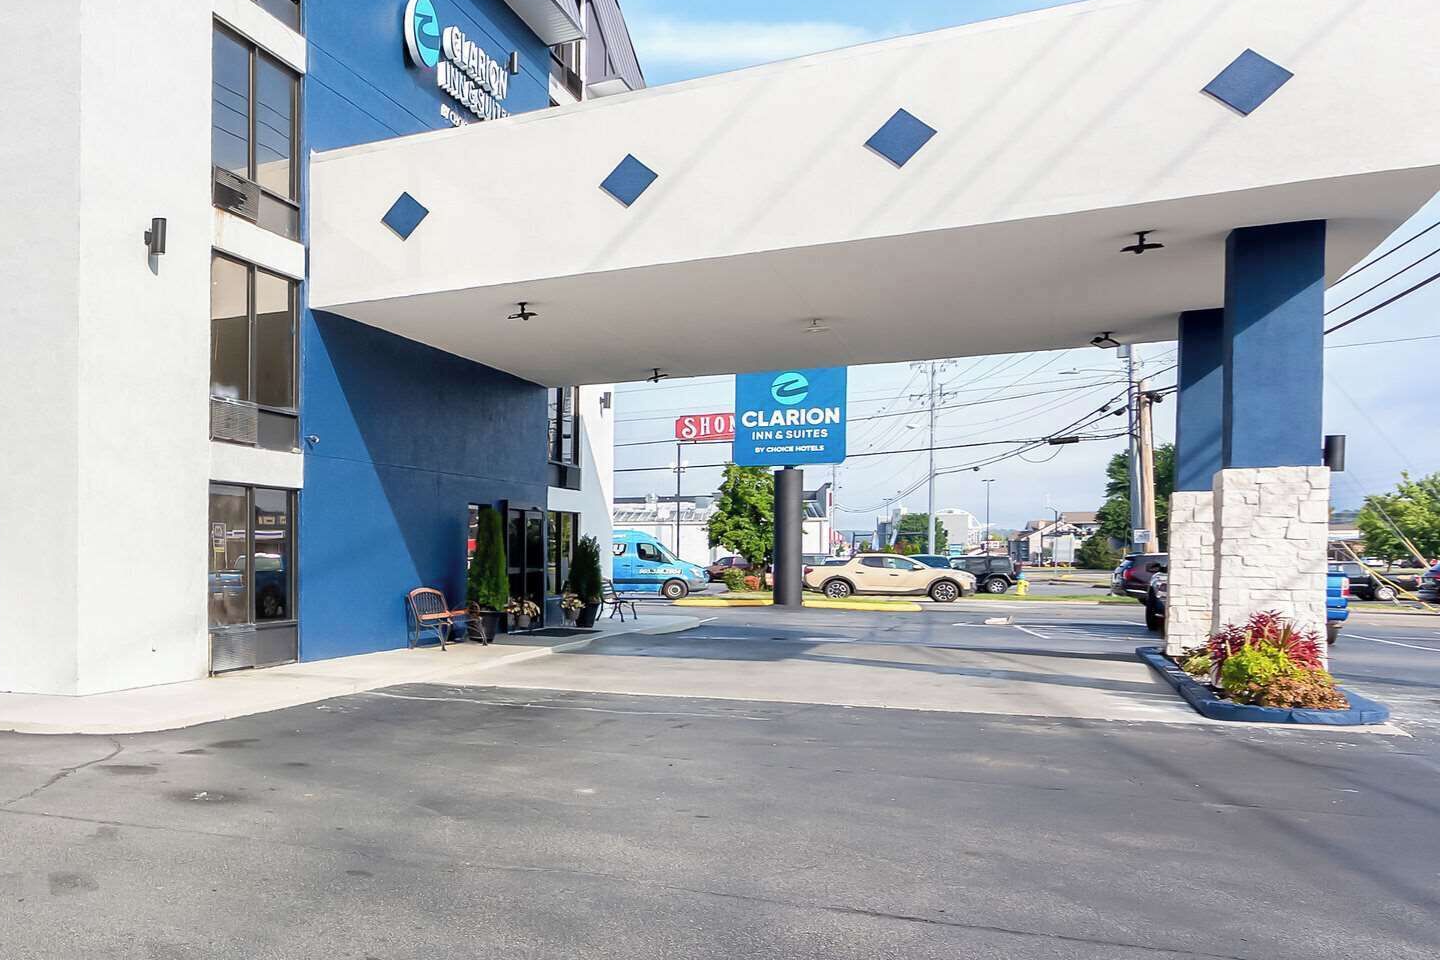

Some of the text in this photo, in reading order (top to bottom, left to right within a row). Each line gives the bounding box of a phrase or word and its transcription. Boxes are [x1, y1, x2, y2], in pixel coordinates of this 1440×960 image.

[443, 26, 508, 101] CLARION
[477, 87, 512, 120] SUIT
[741, 407, 840, 428] CLARION
[752, 428, 829, 441] INN & SUITES
[766, 445, 794, 453] CHOICE
[795, 444, 825, 452] HOTELS
